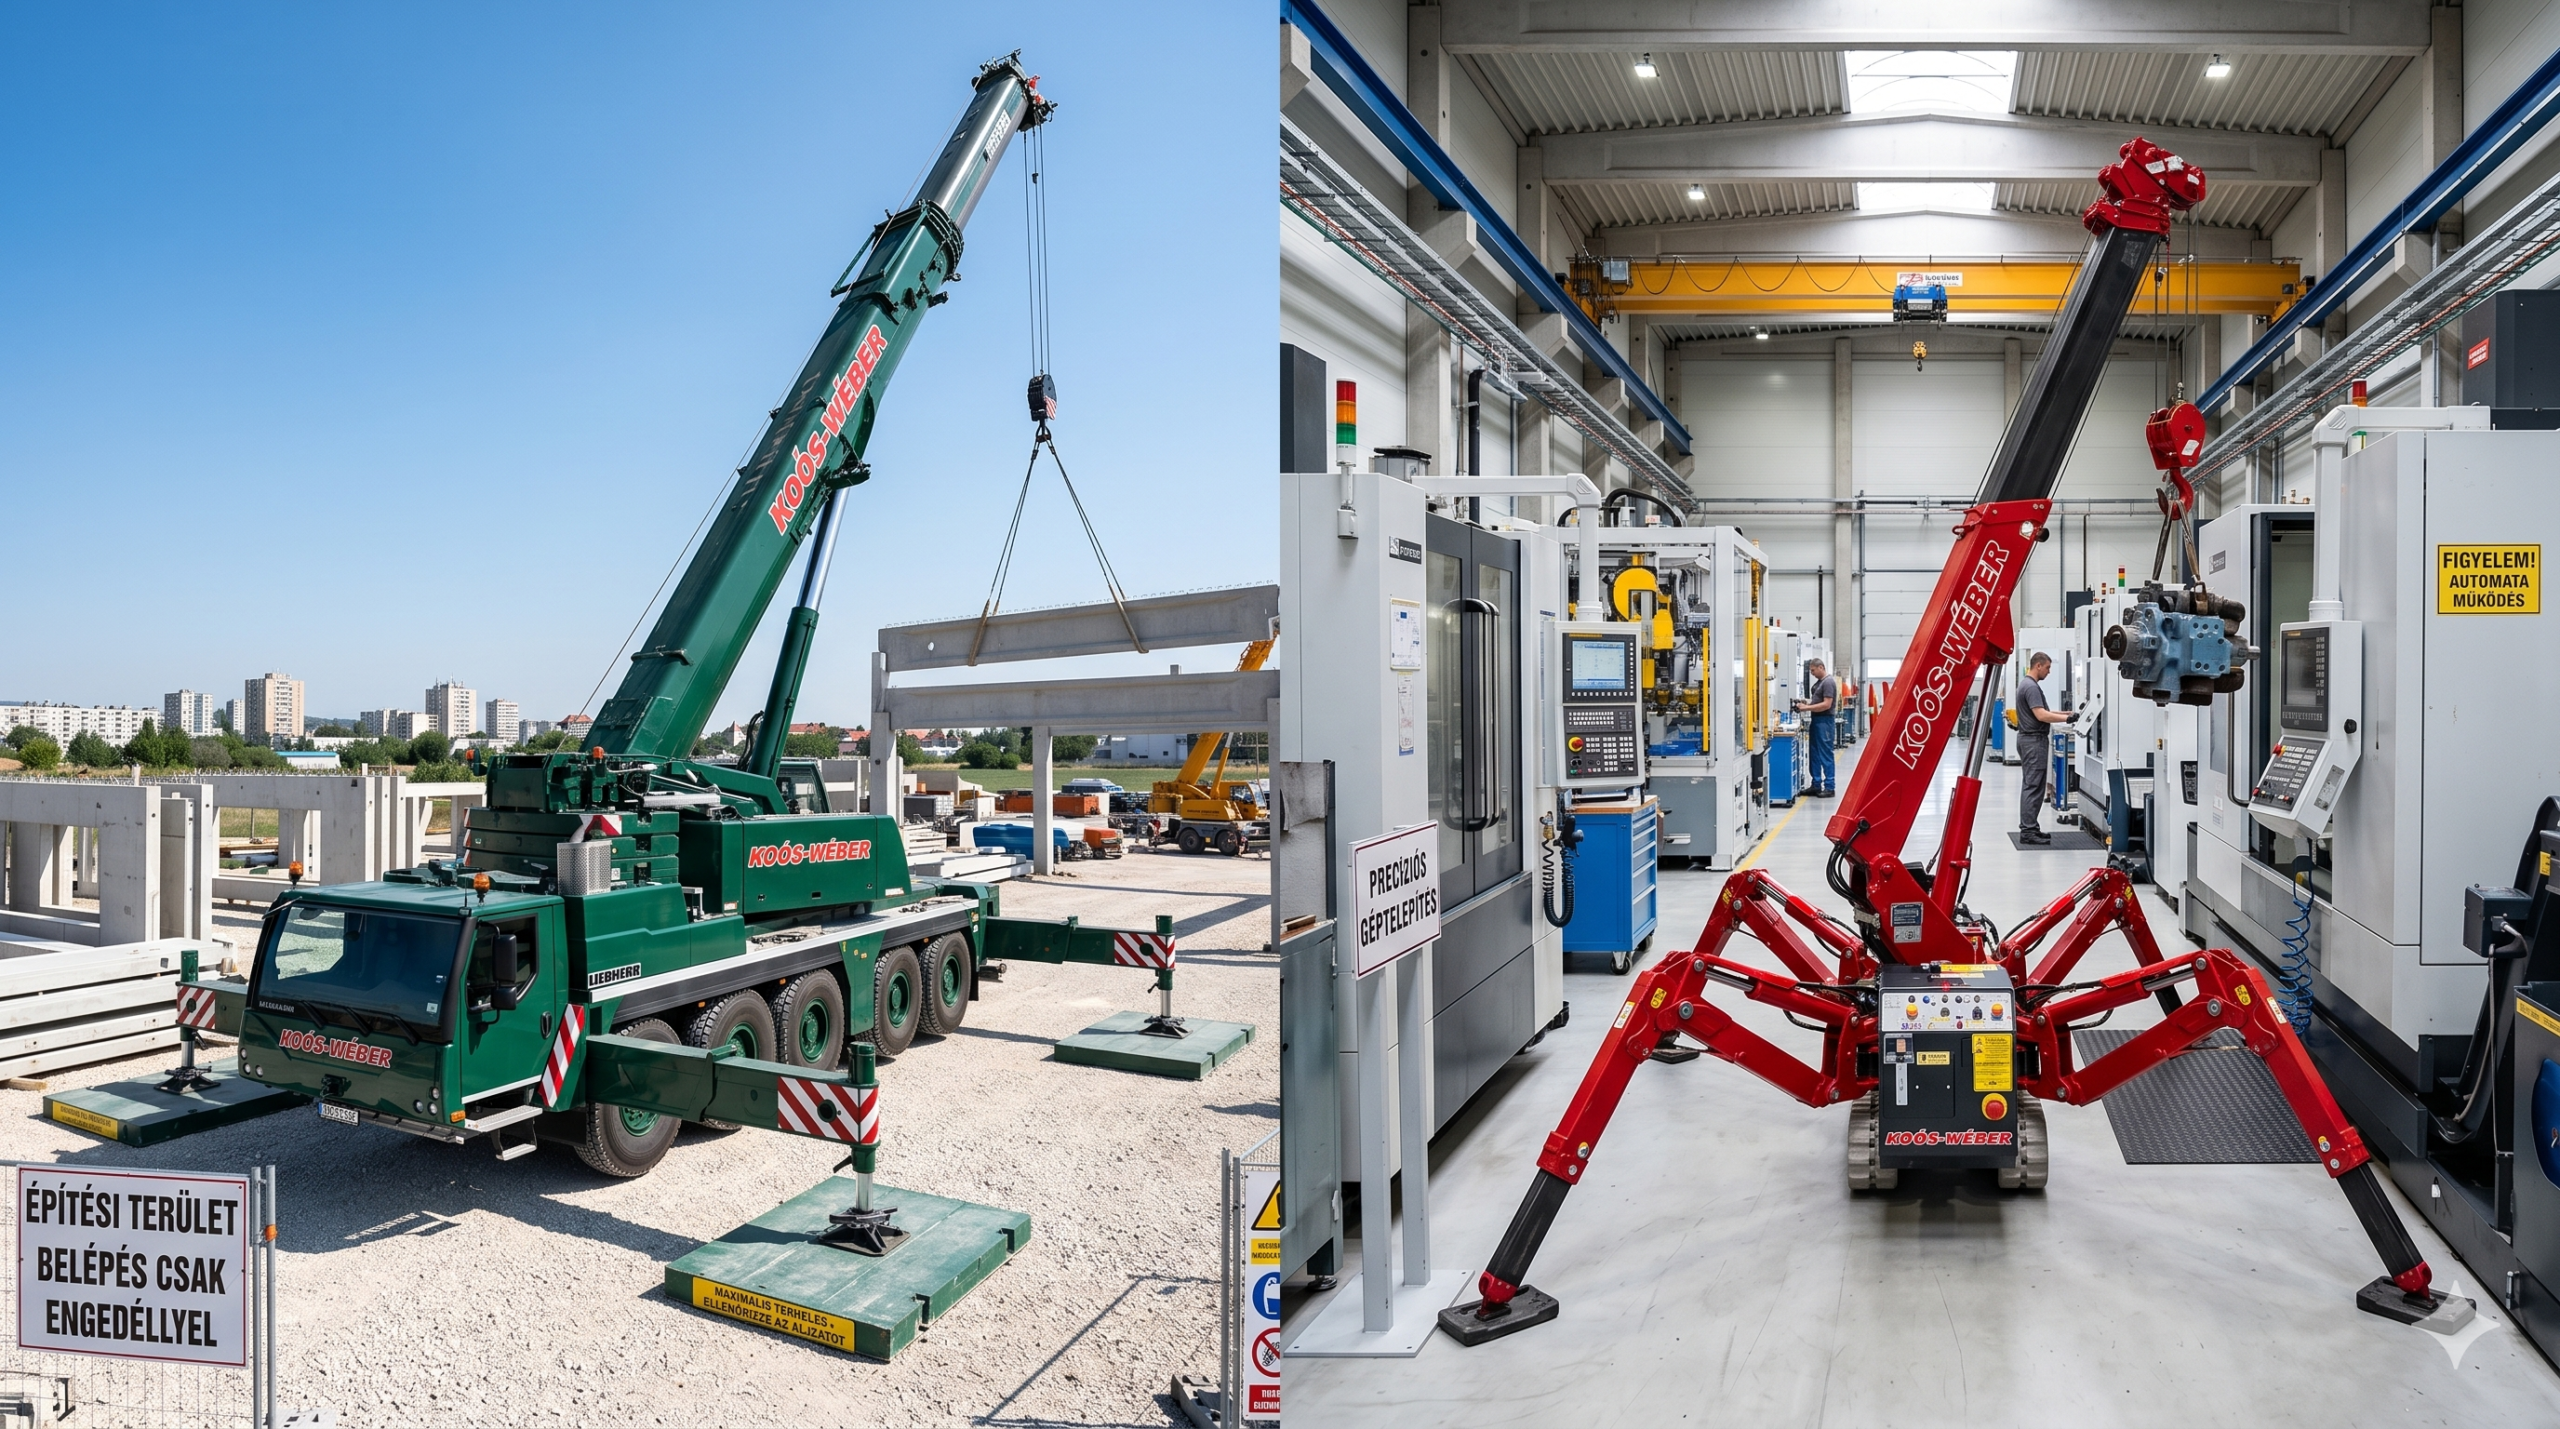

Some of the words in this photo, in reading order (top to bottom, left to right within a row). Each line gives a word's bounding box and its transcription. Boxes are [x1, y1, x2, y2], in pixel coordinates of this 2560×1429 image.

[768, 324, 888, 537] KOÓS-WÉBER
[2443, 552, 2535, 568] FIGYELEM!
[2449, 574, 2530, 588] AUTOMATA
[1893, 539, 2010, 770] KOÓS-WÉBER
[748, 838, 872, 868] KOÓS-WÉBER
[1360, 886, 1437, 947] GÉPTELEPÍTÉS
[589, 964, 641, 987] LIEBHERR
[279, 1029, 393, 1069] KOÓS-WÉBER
[1885, 1128, 2013, 1146] KOÓS-WÉBER
[26, 1181, 120, 1229] ÉPÍTÉSI
[128, 1189, 238, 1236] TERÜLET
[38, 1242, 147, 1289] BELÉPÉS
[156, 1254, 226, 1295] CSAK
[46, 1298, 217, 1347] ENGEDÉLLYEL
[774, 1317, 789, 1330] AZ
